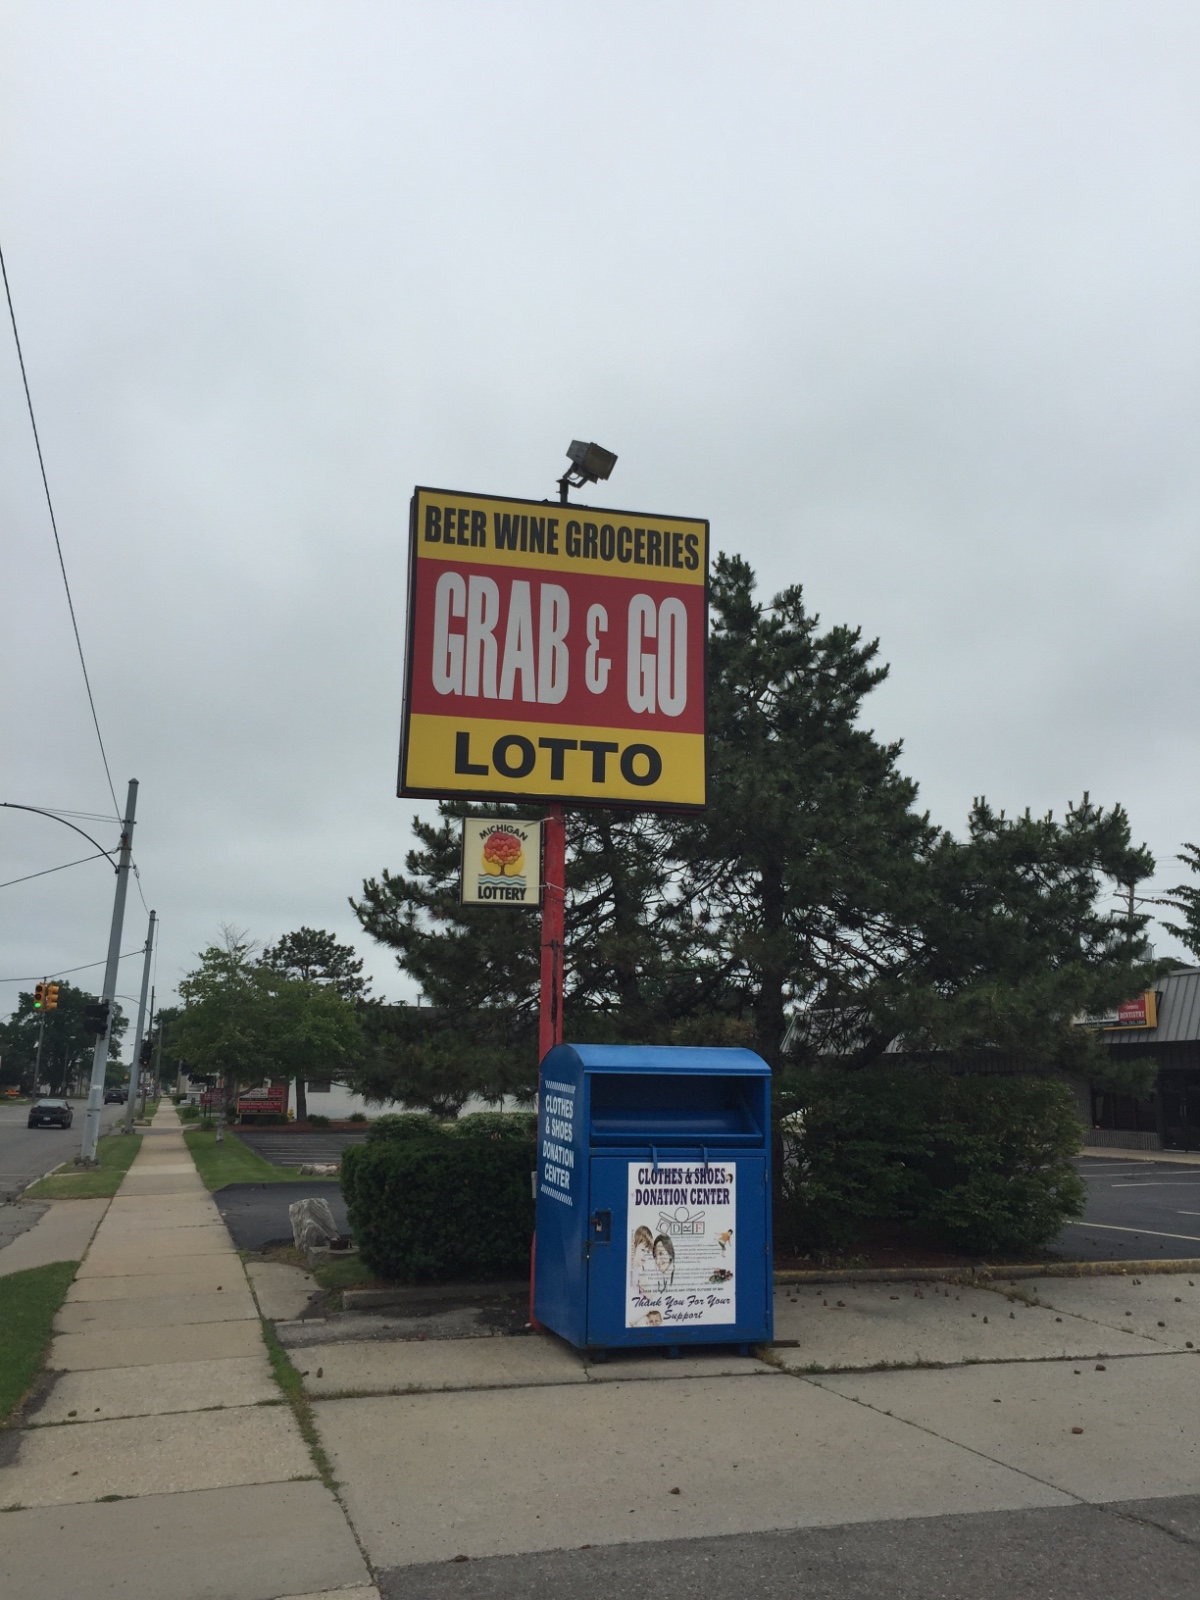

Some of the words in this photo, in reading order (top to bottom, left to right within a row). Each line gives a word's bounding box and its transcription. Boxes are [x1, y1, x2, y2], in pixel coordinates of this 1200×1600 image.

[425, 505, 487, 548] BEER
[494, 512, 559, 555] WINE
[565, 520, 699, 571] GROCERIES
[432, 571, 570, 705] GRAB
[585, 603, 612, 694] &
[627, 593, 687, 717] GO
[454, 731, 662, 786] LOTTO
[479, 824, 528, 841] MICHIGAN
[478, 886, 527, 900] LOTTERY
[545, 1095, 574, 1119] CLOTHES
[545, 1116, 550, 1134] &
[551, 1118, 573, 1142] SHOES
[543, 1140, 574, 1169] DONATION
[544, 1162, 570, 1189] CENTER
[638, 1167, 683, 1185] CLOTHES
[685, 1167, 692, 1185] &
[694, 1167, 726, 1185] SHOES
[635, 1188, 688, 1206] DONATION
[690, 1188, 730, 1205] CENTER
[632, 1295, 662, 1308] Thank
[665, 1296, 685, 1309] You
[687, 1295, 705, 1308] For
[707, 1294, 731, 1308] Your
[663, 1309, 703, 1323] Support
